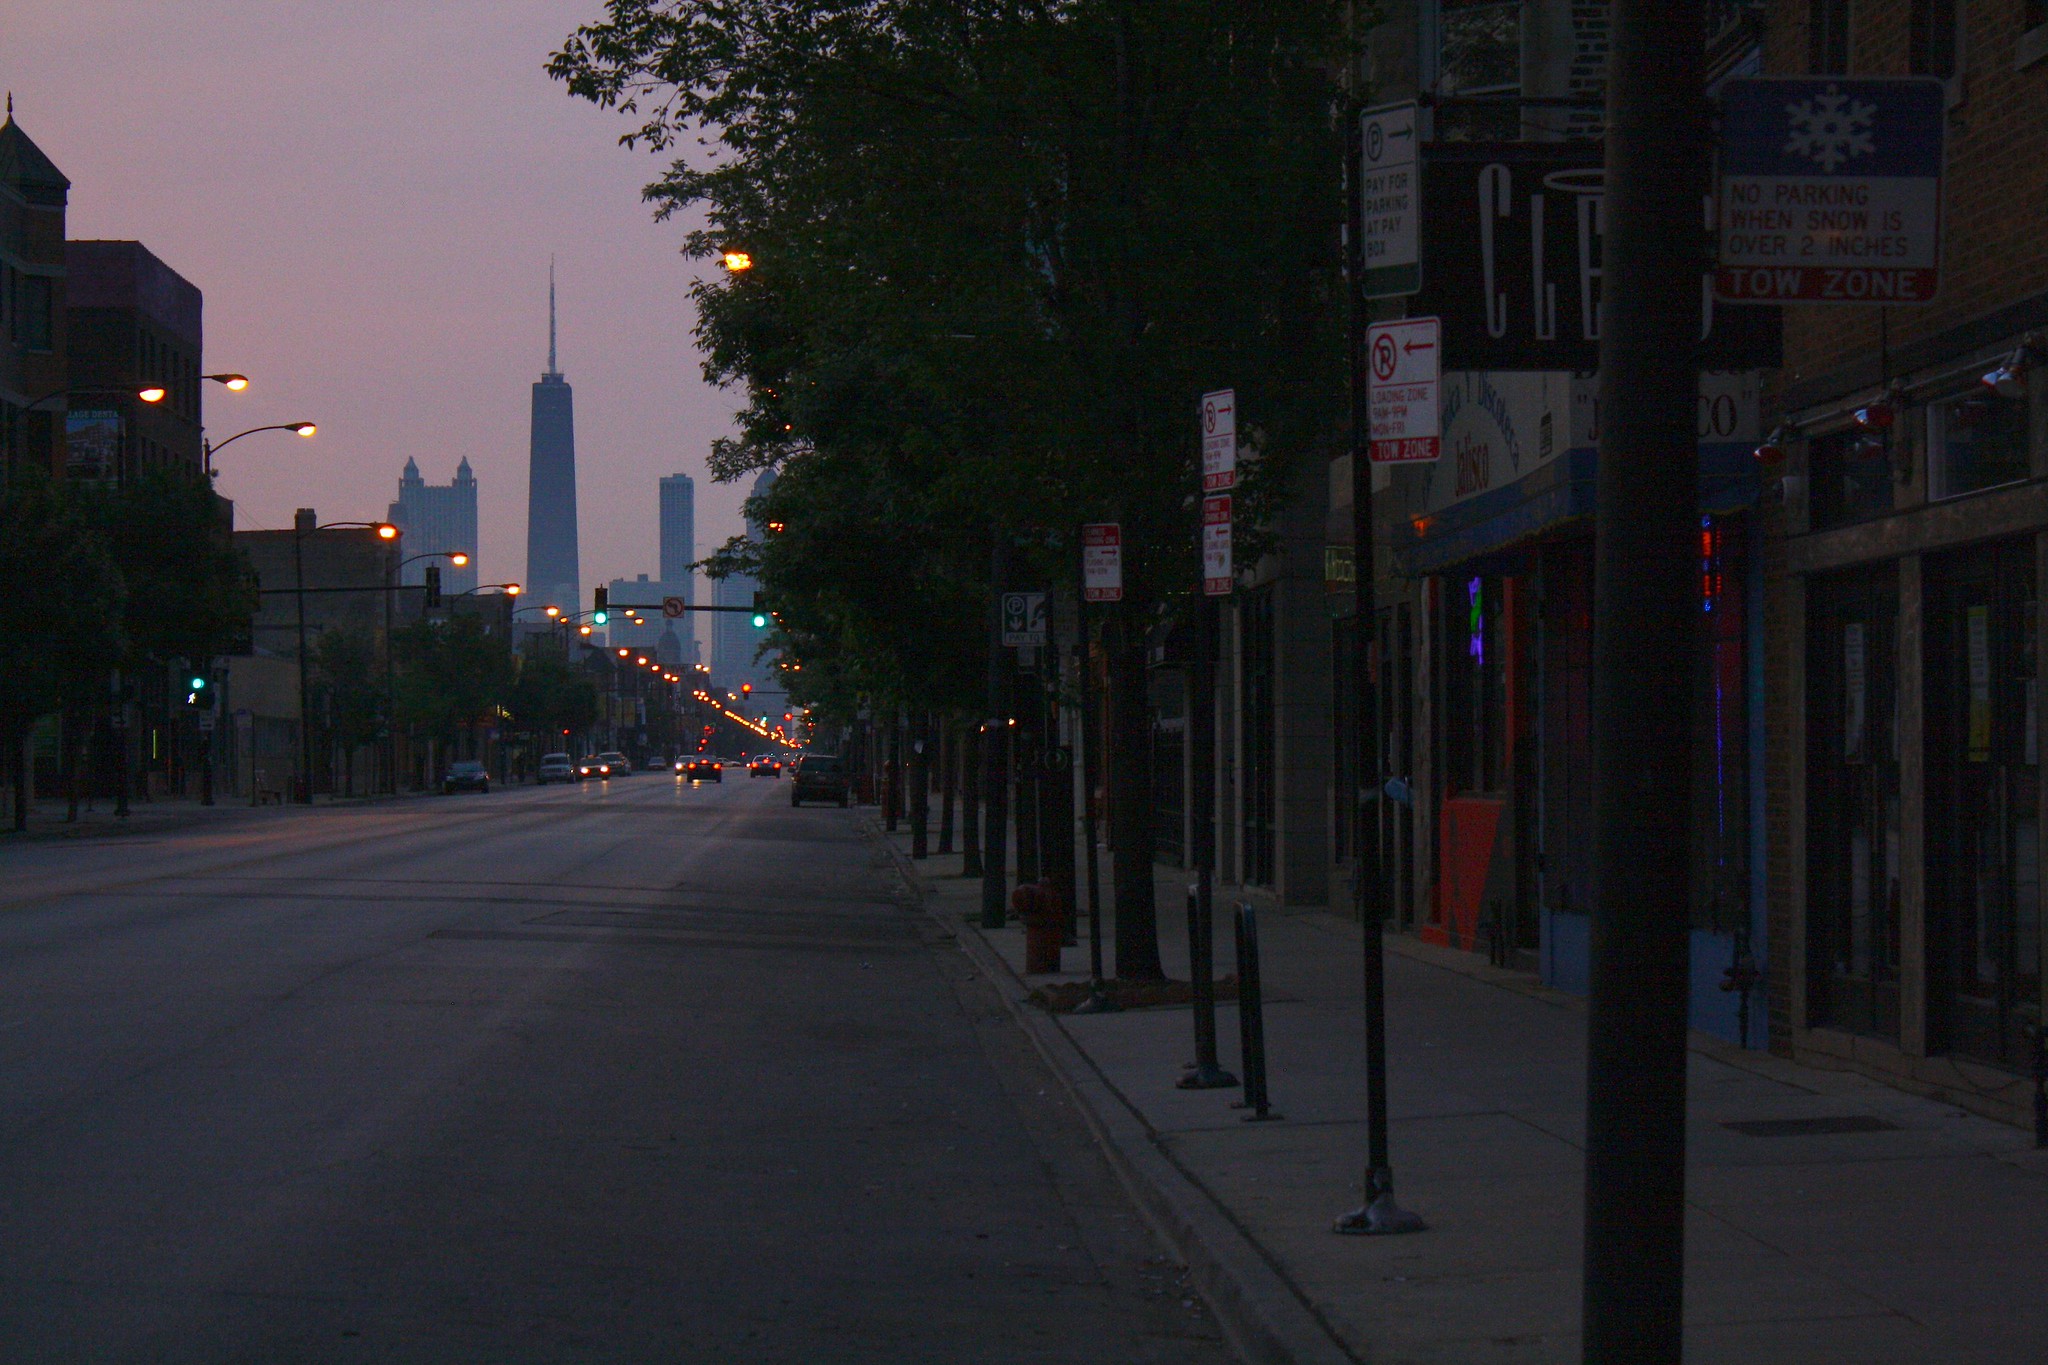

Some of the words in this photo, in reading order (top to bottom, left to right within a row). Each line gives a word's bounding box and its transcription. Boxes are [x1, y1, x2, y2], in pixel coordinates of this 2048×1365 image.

[1366, 177, 1385, 194] PAY
[1388, 172, 1408, 192] FOR
[1731, 183, 1760, 204] NO
[1776, 184, 1869, 205] PARKING
[1366, 194, 1408, 215] PARKING
[1367, 219, 1379, 236] AT
[1382, 216, 1402, 234] PAY
[1731, 209, 1792, 230] WHEN
[1807, 210, 1869, 231] SNOW
[1883, 211, 1901, 231] IS
[1367, 240, 1385, 258] BOX
[1729, 235, 1786, 255] OVER
[1801, 235, 1814, 256] 2
[1829, 236, 1908, 257] INCHES
[1728, 269, 1802, 297] TOW
[1823, 270, 1917, 298] ZONE
[1372, 390, 1405, 404] LOADING
[1407, 387, 1428, 401] ZONE
[1372, 421, 1405, 436] MON-FRI
[1377, 441, 1399, 459] TOW
[1403, 439, 1432, 458] ZONE
[1103, 588, 1118, 599] ZONE
[1008, 634, 1026, 642] PAY
